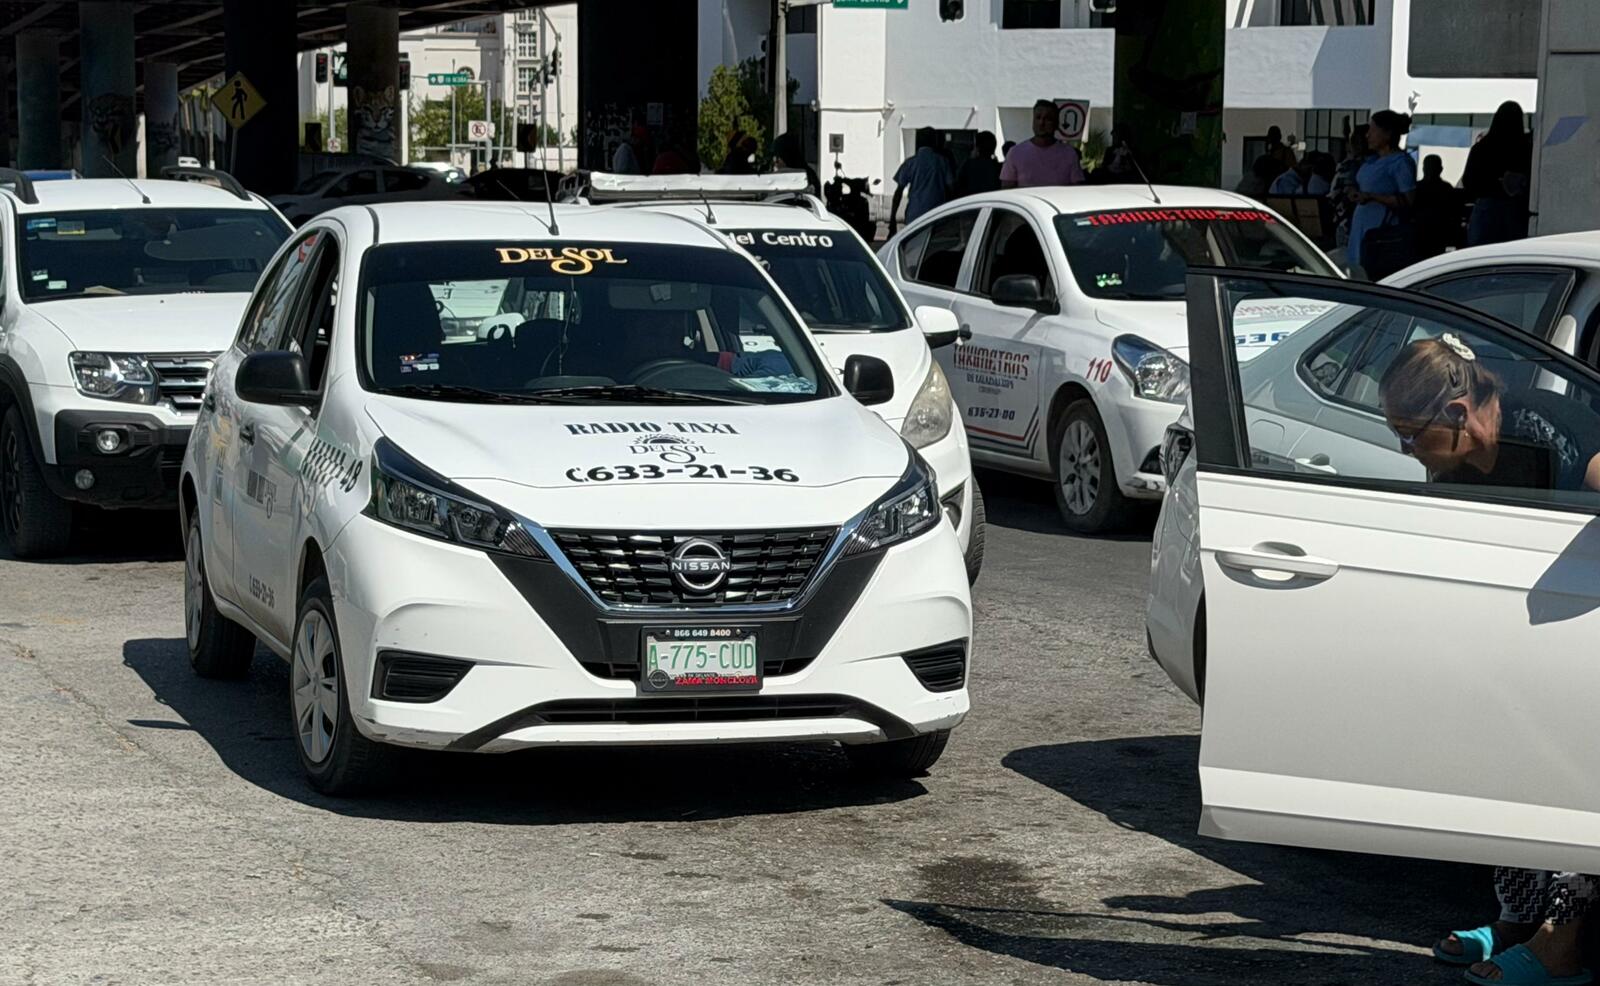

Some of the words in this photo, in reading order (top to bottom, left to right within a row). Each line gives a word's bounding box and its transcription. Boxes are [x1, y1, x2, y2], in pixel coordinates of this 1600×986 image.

[762, 232, 834, 248] Centro
[1086, 357, 1112, 383] 110
[563, 422, 662, 435] RADIO
[667, 422, 741, 435] TAXI
[340, 459, 363, 493] 48
[586, 464, 800, 483] 633-21-36
[671, 561, 730, 571] NISSAN
[674, 629, 690, 637] 866
[692, 629, 708, 637] 649
[710, 629, 731, 637] 8400
[648, 643, 755, 671] A-775-CUD
